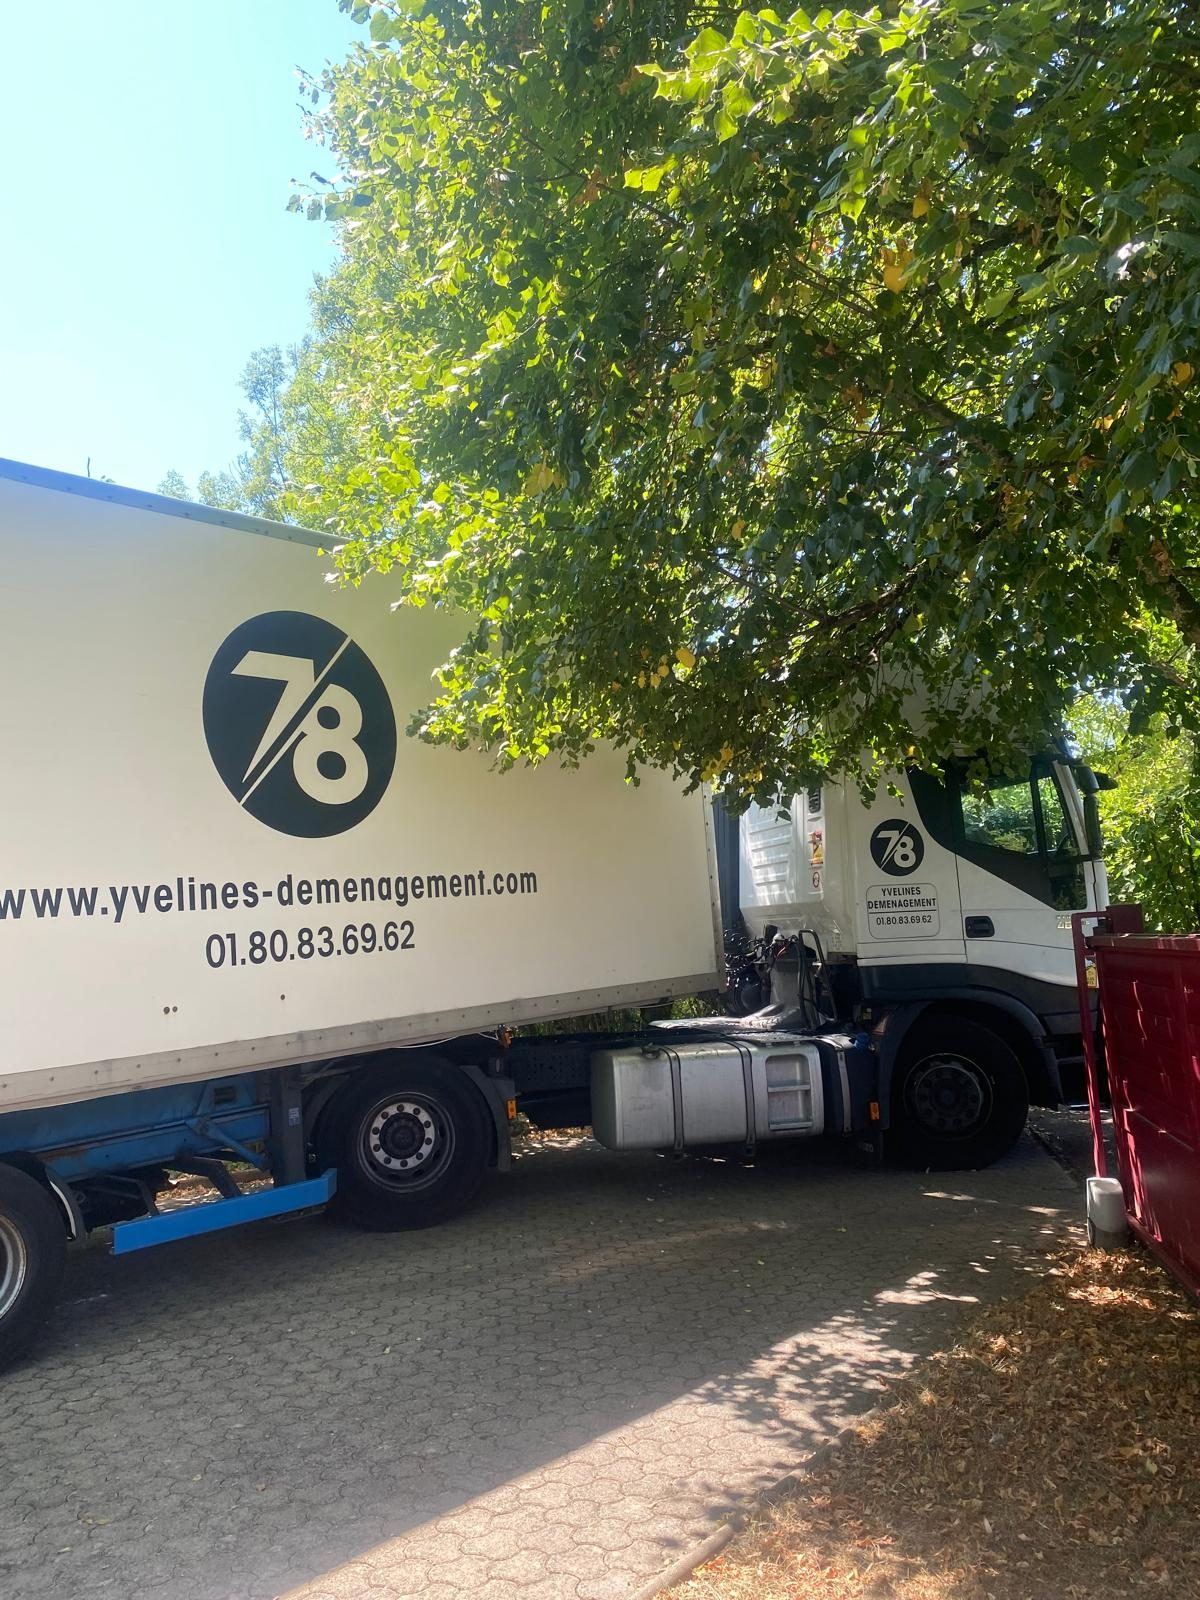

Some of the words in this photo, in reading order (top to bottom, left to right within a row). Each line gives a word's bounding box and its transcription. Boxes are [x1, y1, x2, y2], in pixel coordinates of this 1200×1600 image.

[231, 650, 369, 805] 78
[877, 830, 917, 868] 78
[0, 869, 538, 923] www.yvelines-demenagement.com
[867, 898, 936, 910] DEMENAGEMENT
[881, 887, 921, 897] YVELINES
[877, 915, 932, 926] 01.80.83.69.62
[205, 920, 416, 968] 01.80.83.69.62
